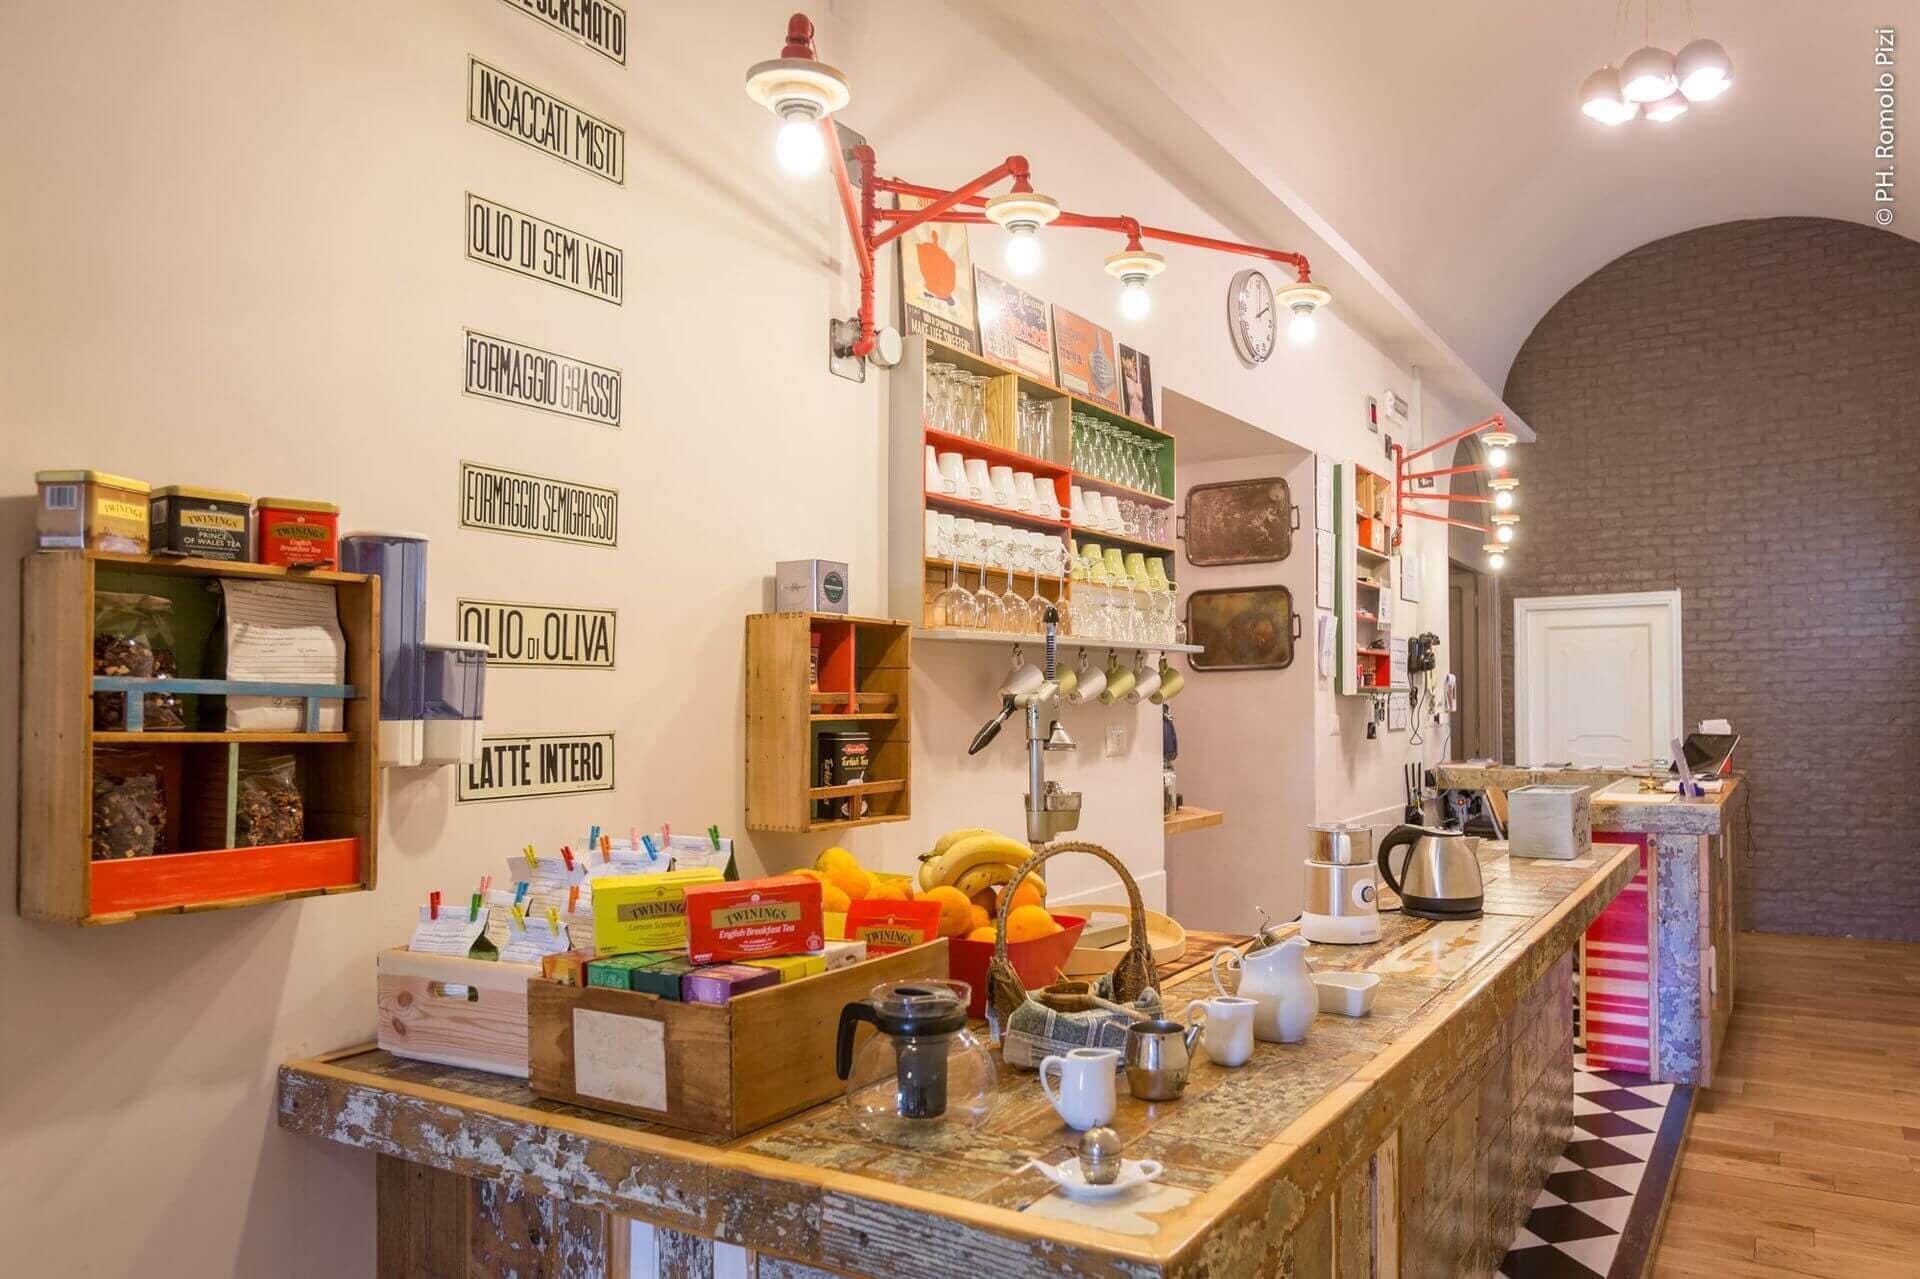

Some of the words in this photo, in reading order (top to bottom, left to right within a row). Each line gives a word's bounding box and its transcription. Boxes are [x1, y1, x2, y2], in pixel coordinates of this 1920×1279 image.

[480, 68, 568, 155] INSACCATI
[575, 115, 616, 177] MISTI
[473, 203, 513, 261] OLIO
[520, 219, 537, 270] DI
[543, 228, 580, 284] SEMI
[585, 242, 619, 298] VARI
[468, 338, 557, 405] FORMAGGIO
[560, 363, 619, 420] GRASSO
[104, 503, 144, 519] TWININGS
[466, 470, 541, 530] FORMAGGIO
[542, 484, 614, 541] SEMIGRASSO
[186, 514, 239, 528] TWININGS
[183, 536, 195, 545] OF
[197, 538, 225, 547] WALES
[275, 527, 326, 539] TWININGS
[464, 607, 524, 660] OLIO
[527, 637, 540, 660] DI
[543, 612, 610, 662] OLIVA
[468, 744, 531, 790] LATTE
[539, 742, 603, 784] INTERO
[632, 902, 687, 920] TWINING
[726, 908, 788, 925] TWININGS
[719, 927, 746, 940] English
[746, 924, 782, 937] Breakfast
[782, 924, 796, 933] Tea
[864, 930, 912, 945] TWININGS
